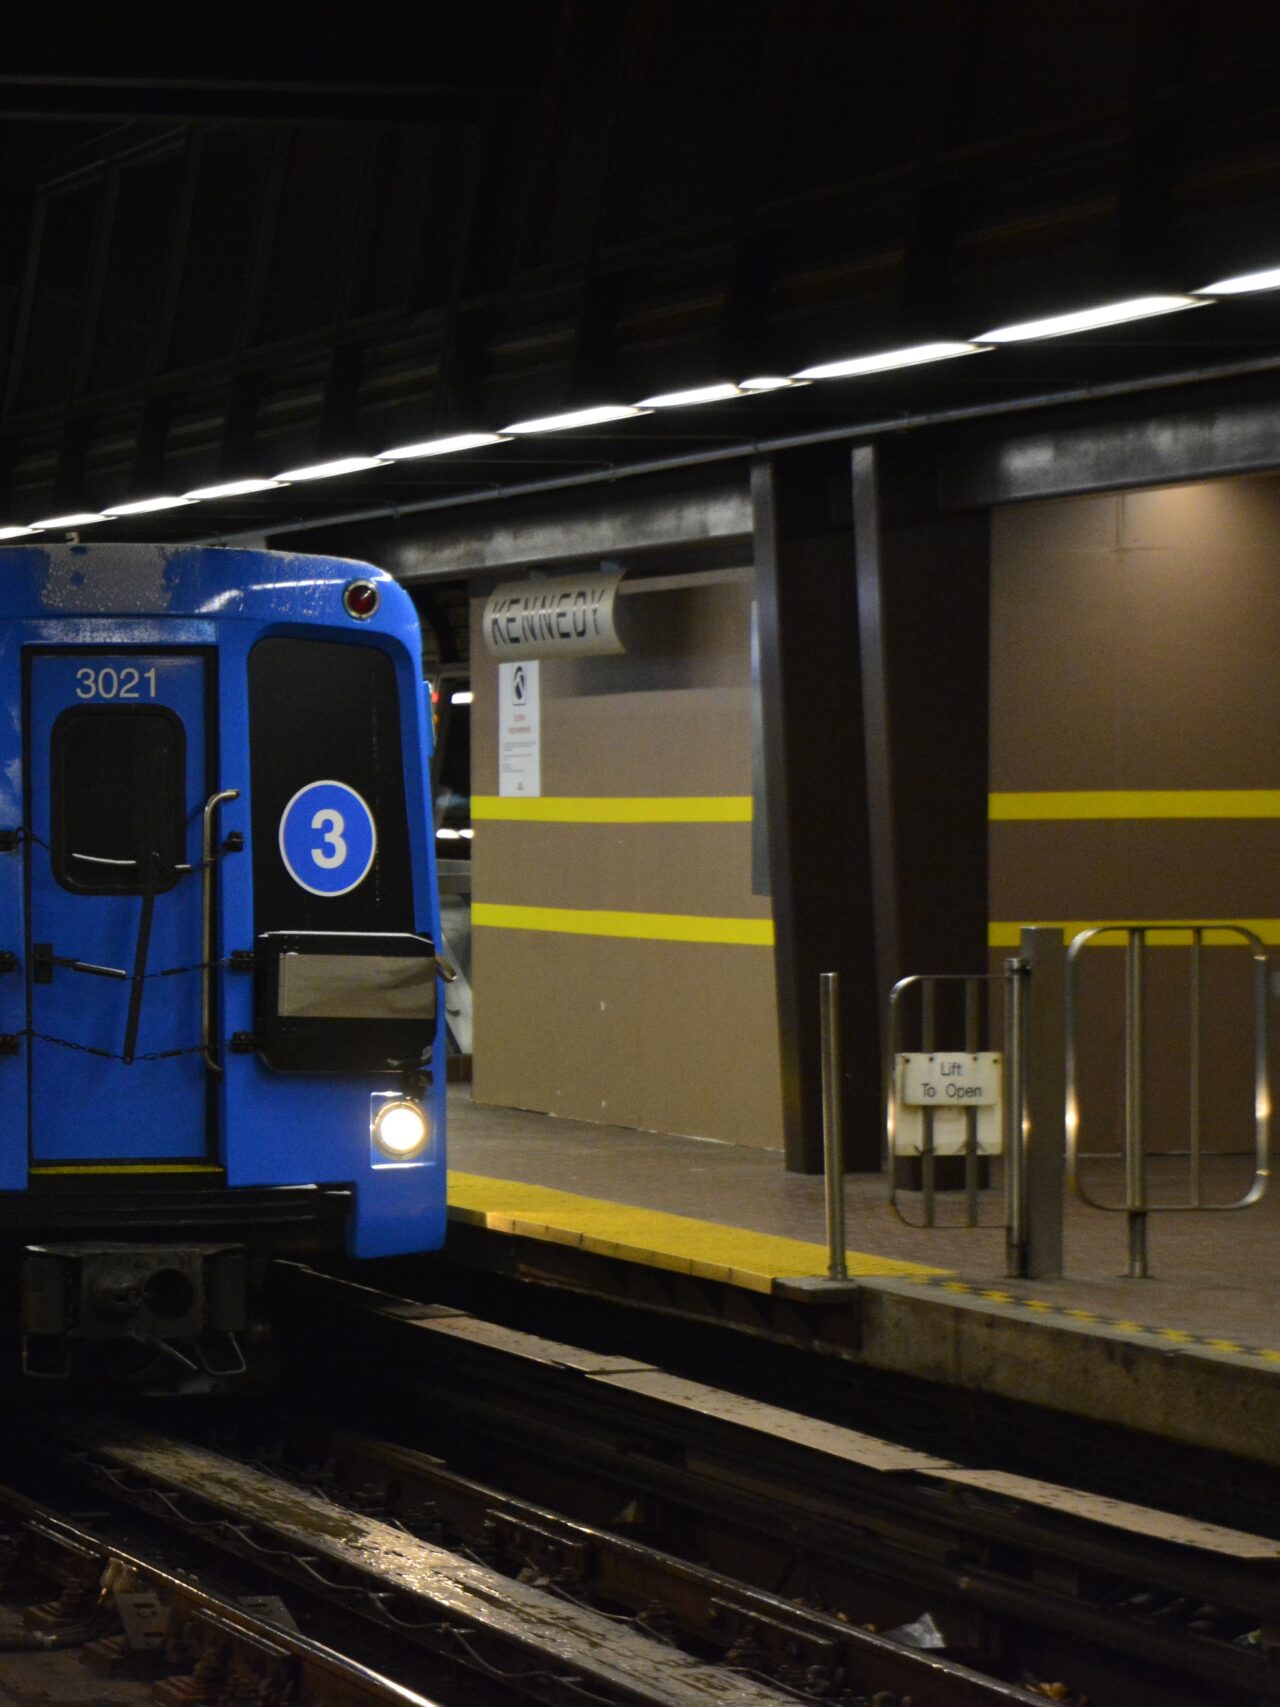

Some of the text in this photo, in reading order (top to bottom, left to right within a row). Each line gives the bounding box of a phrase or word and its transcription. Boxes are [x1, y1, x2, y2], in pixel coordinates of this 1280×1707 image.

[491, 588, 606, 645] KENNEDY
[76, 667, 157, 699] 3021
[311, 809, 347, 869] 3
[940, 1062, 962, 1077] Lift
[920, 1083, 982, 1101] To Open
